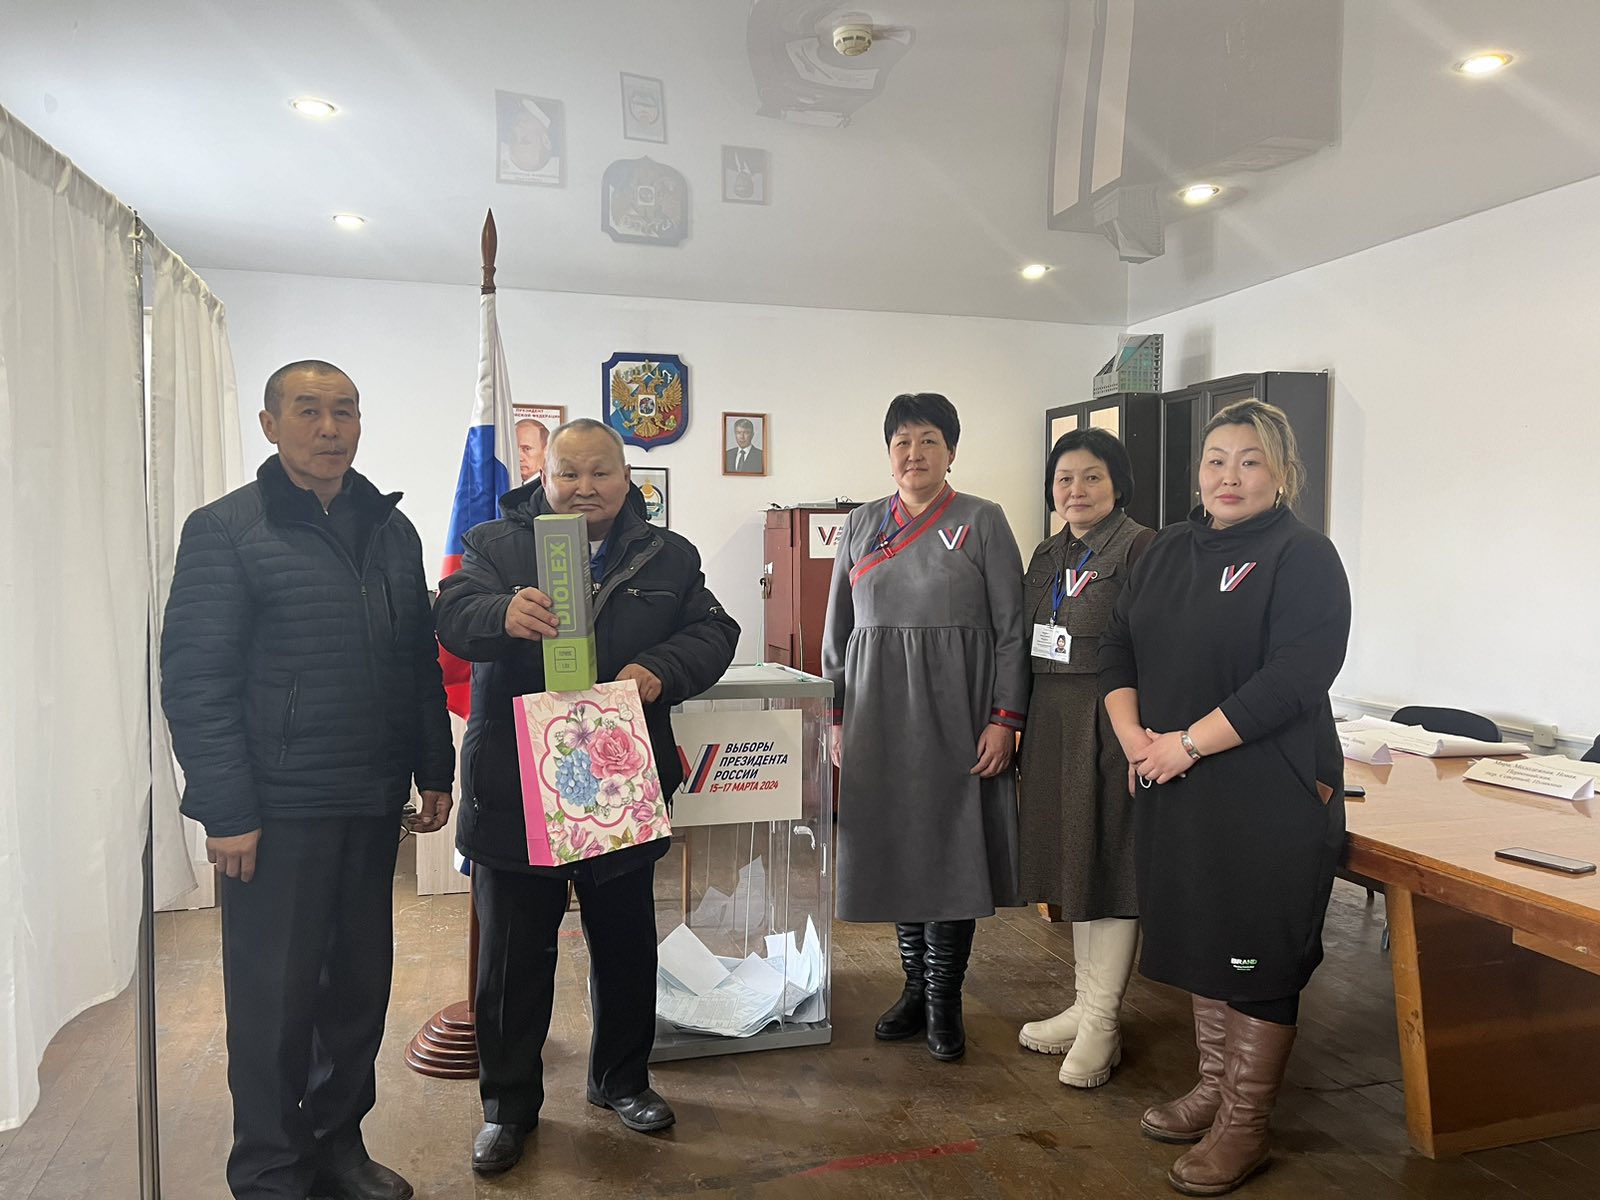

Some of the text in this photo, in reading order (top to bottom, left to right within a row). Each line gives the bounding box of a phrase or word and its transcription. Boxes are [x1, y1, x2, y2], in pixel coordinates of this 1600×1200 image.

[550, 542, 571, 625] DIOLEX
[725, 742, 774, 753] ВЫБОРЫ
[719, 754, 788, 767] ПРЕЗИДЕНТА
[713, 769, 759, 781] РОССИИ
[731, 781, 760, 792] МАРТА
[759, 780, 779, 791] 2024
